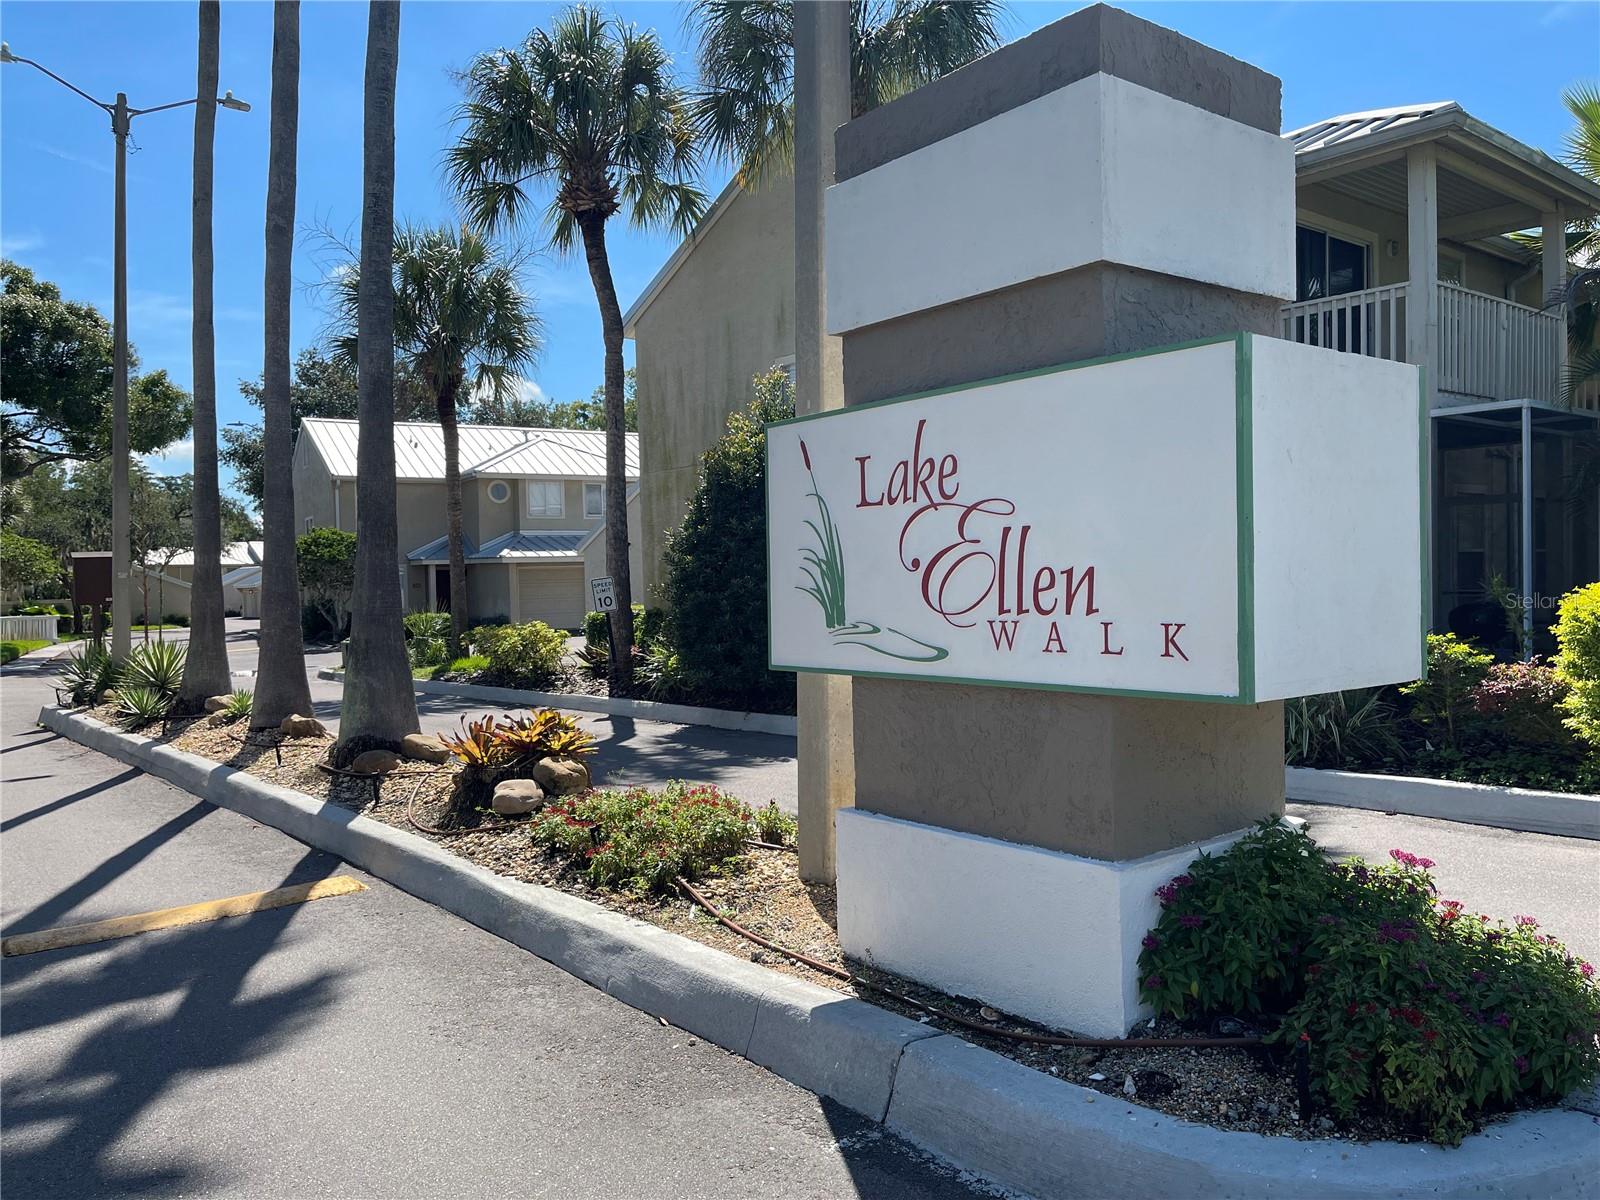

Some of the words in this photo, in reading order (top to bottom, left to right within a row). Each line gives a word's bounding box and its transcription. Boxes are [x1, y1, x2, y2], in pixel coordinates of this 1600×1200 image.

[856, 419, 960, 510] Lake
[899, 498, 1099, 628] Ellen
[598, 596, 613, 608] 10
[987, 620, 1190, 662] WALK
